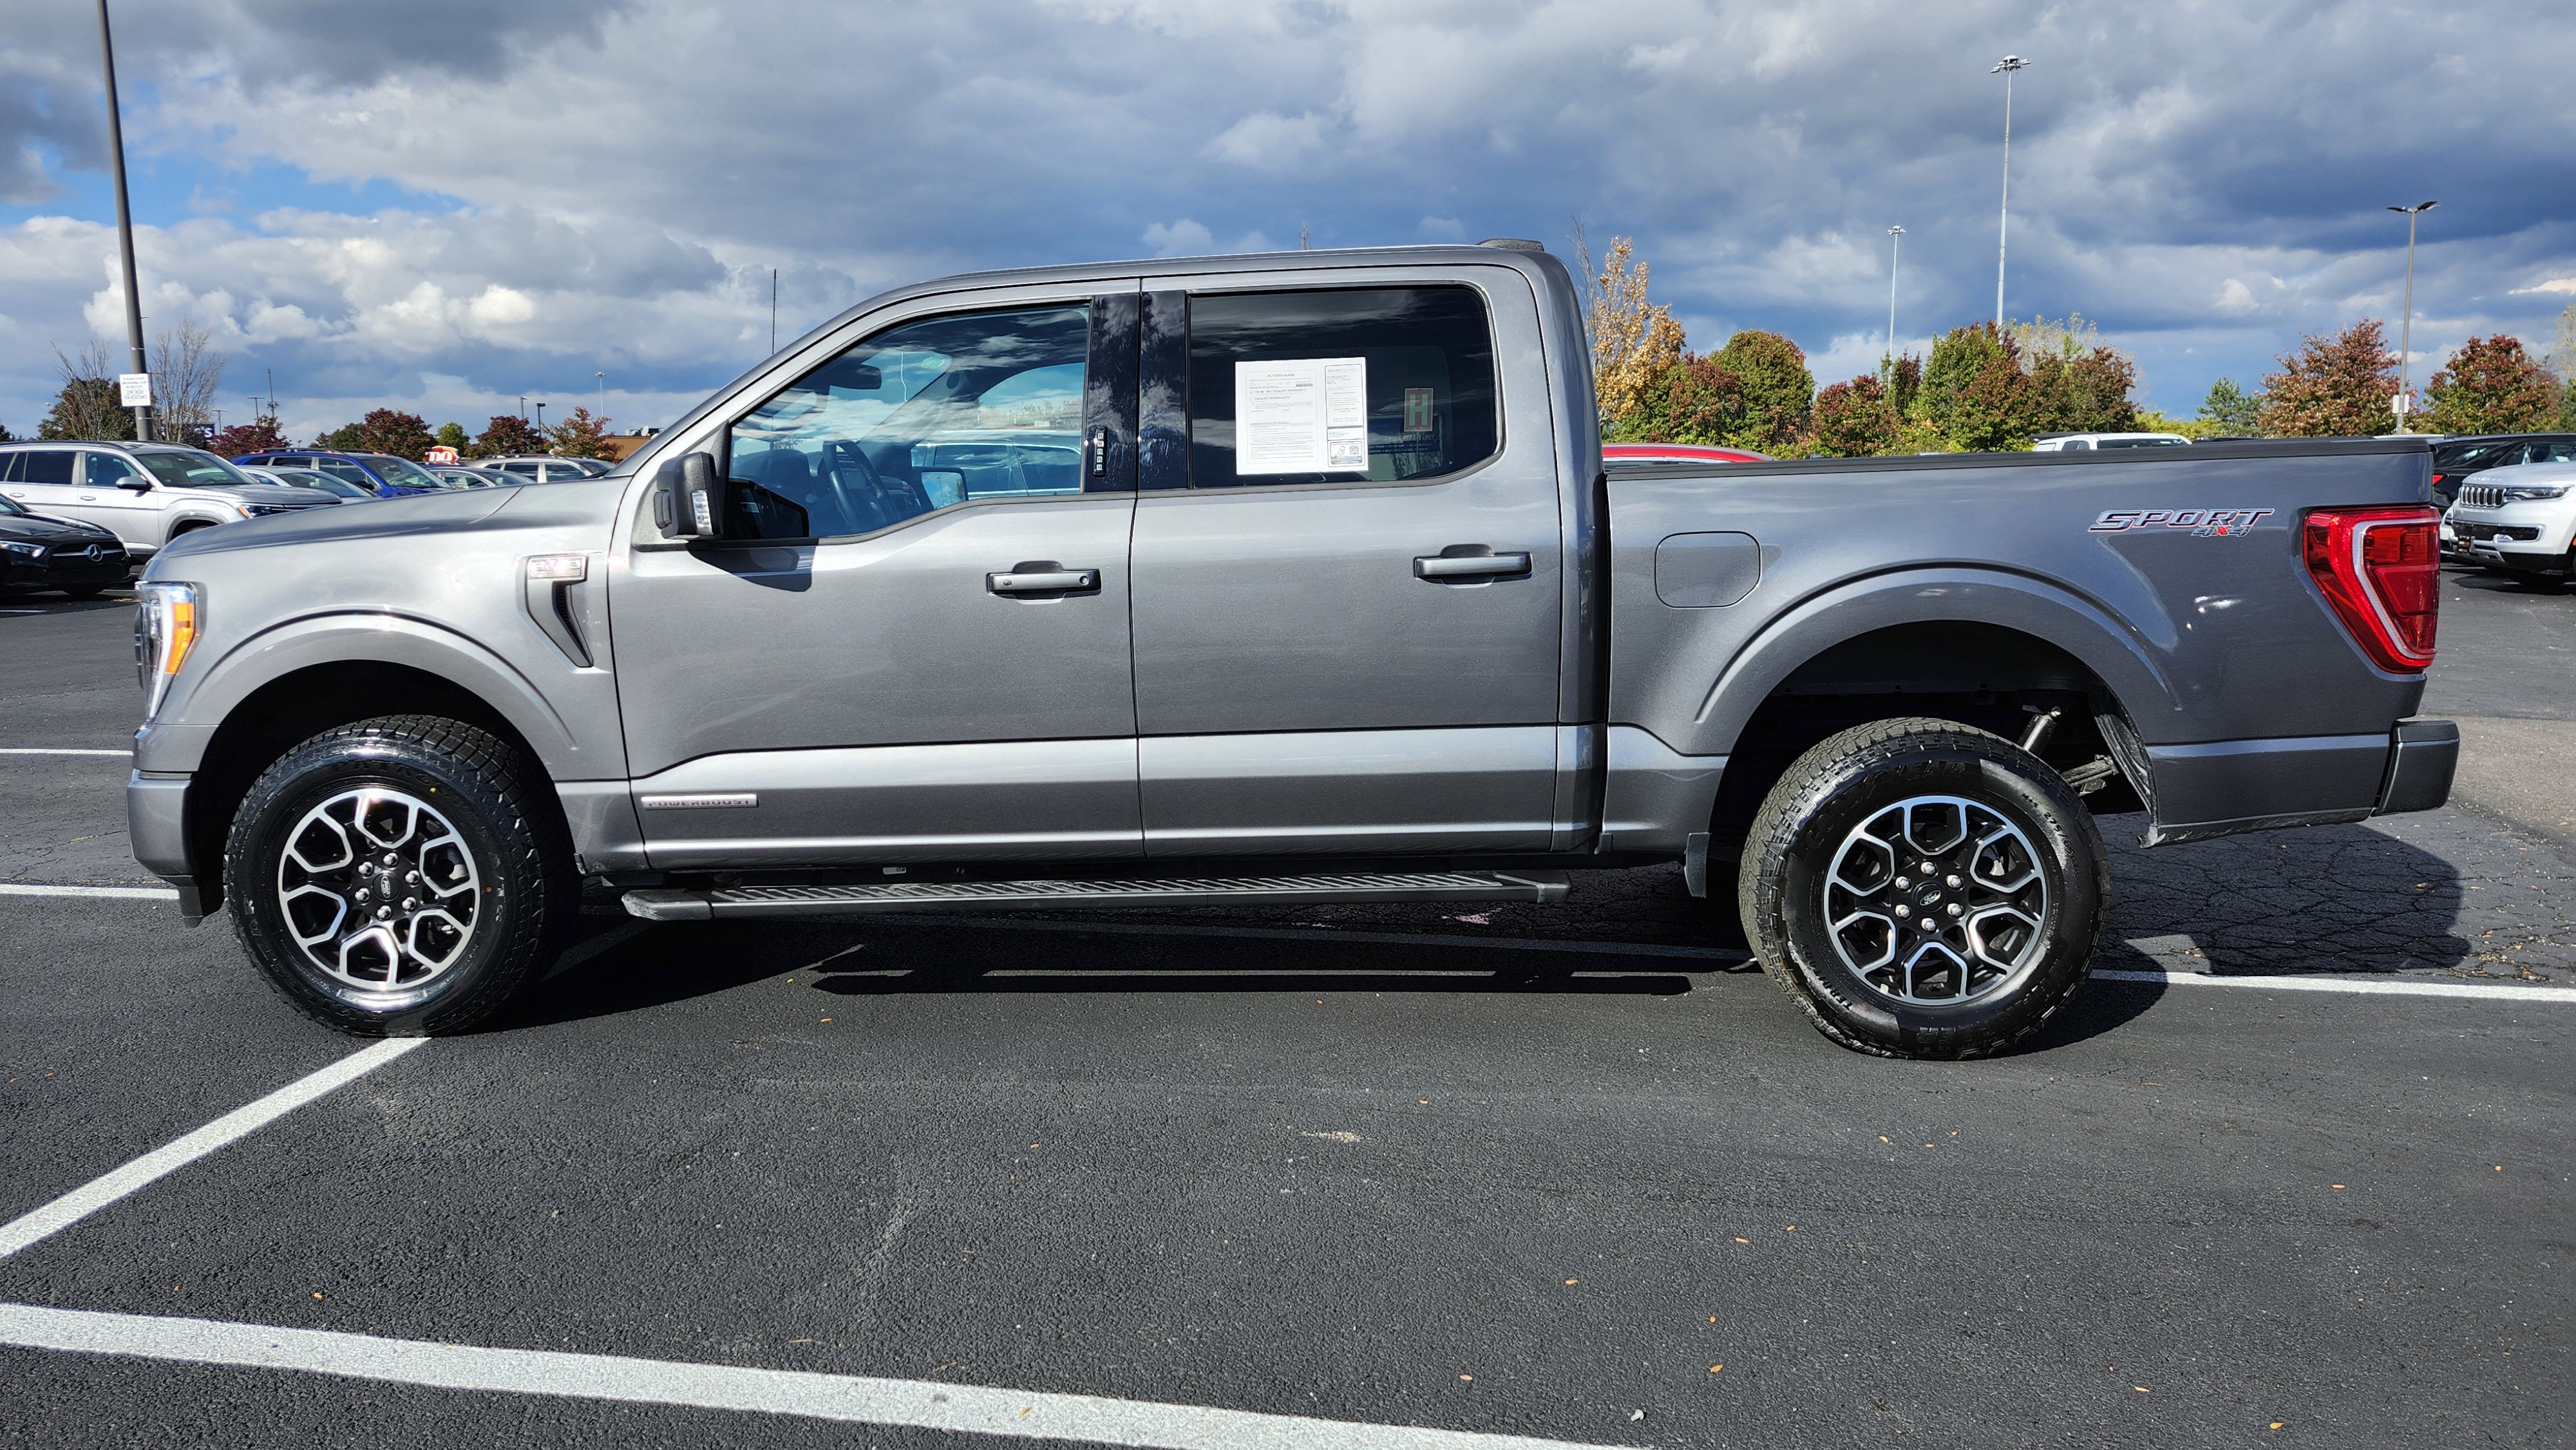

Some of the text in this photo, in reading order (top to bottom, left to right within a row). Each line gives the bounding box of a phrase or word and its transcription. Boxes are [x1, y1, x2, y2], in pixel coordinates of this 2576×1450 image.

[1408, 393, 1428, 426] H
[2087, 508, 2276, 532] SPORT
[1803, 760, 1966, 850] GOODYEAR
